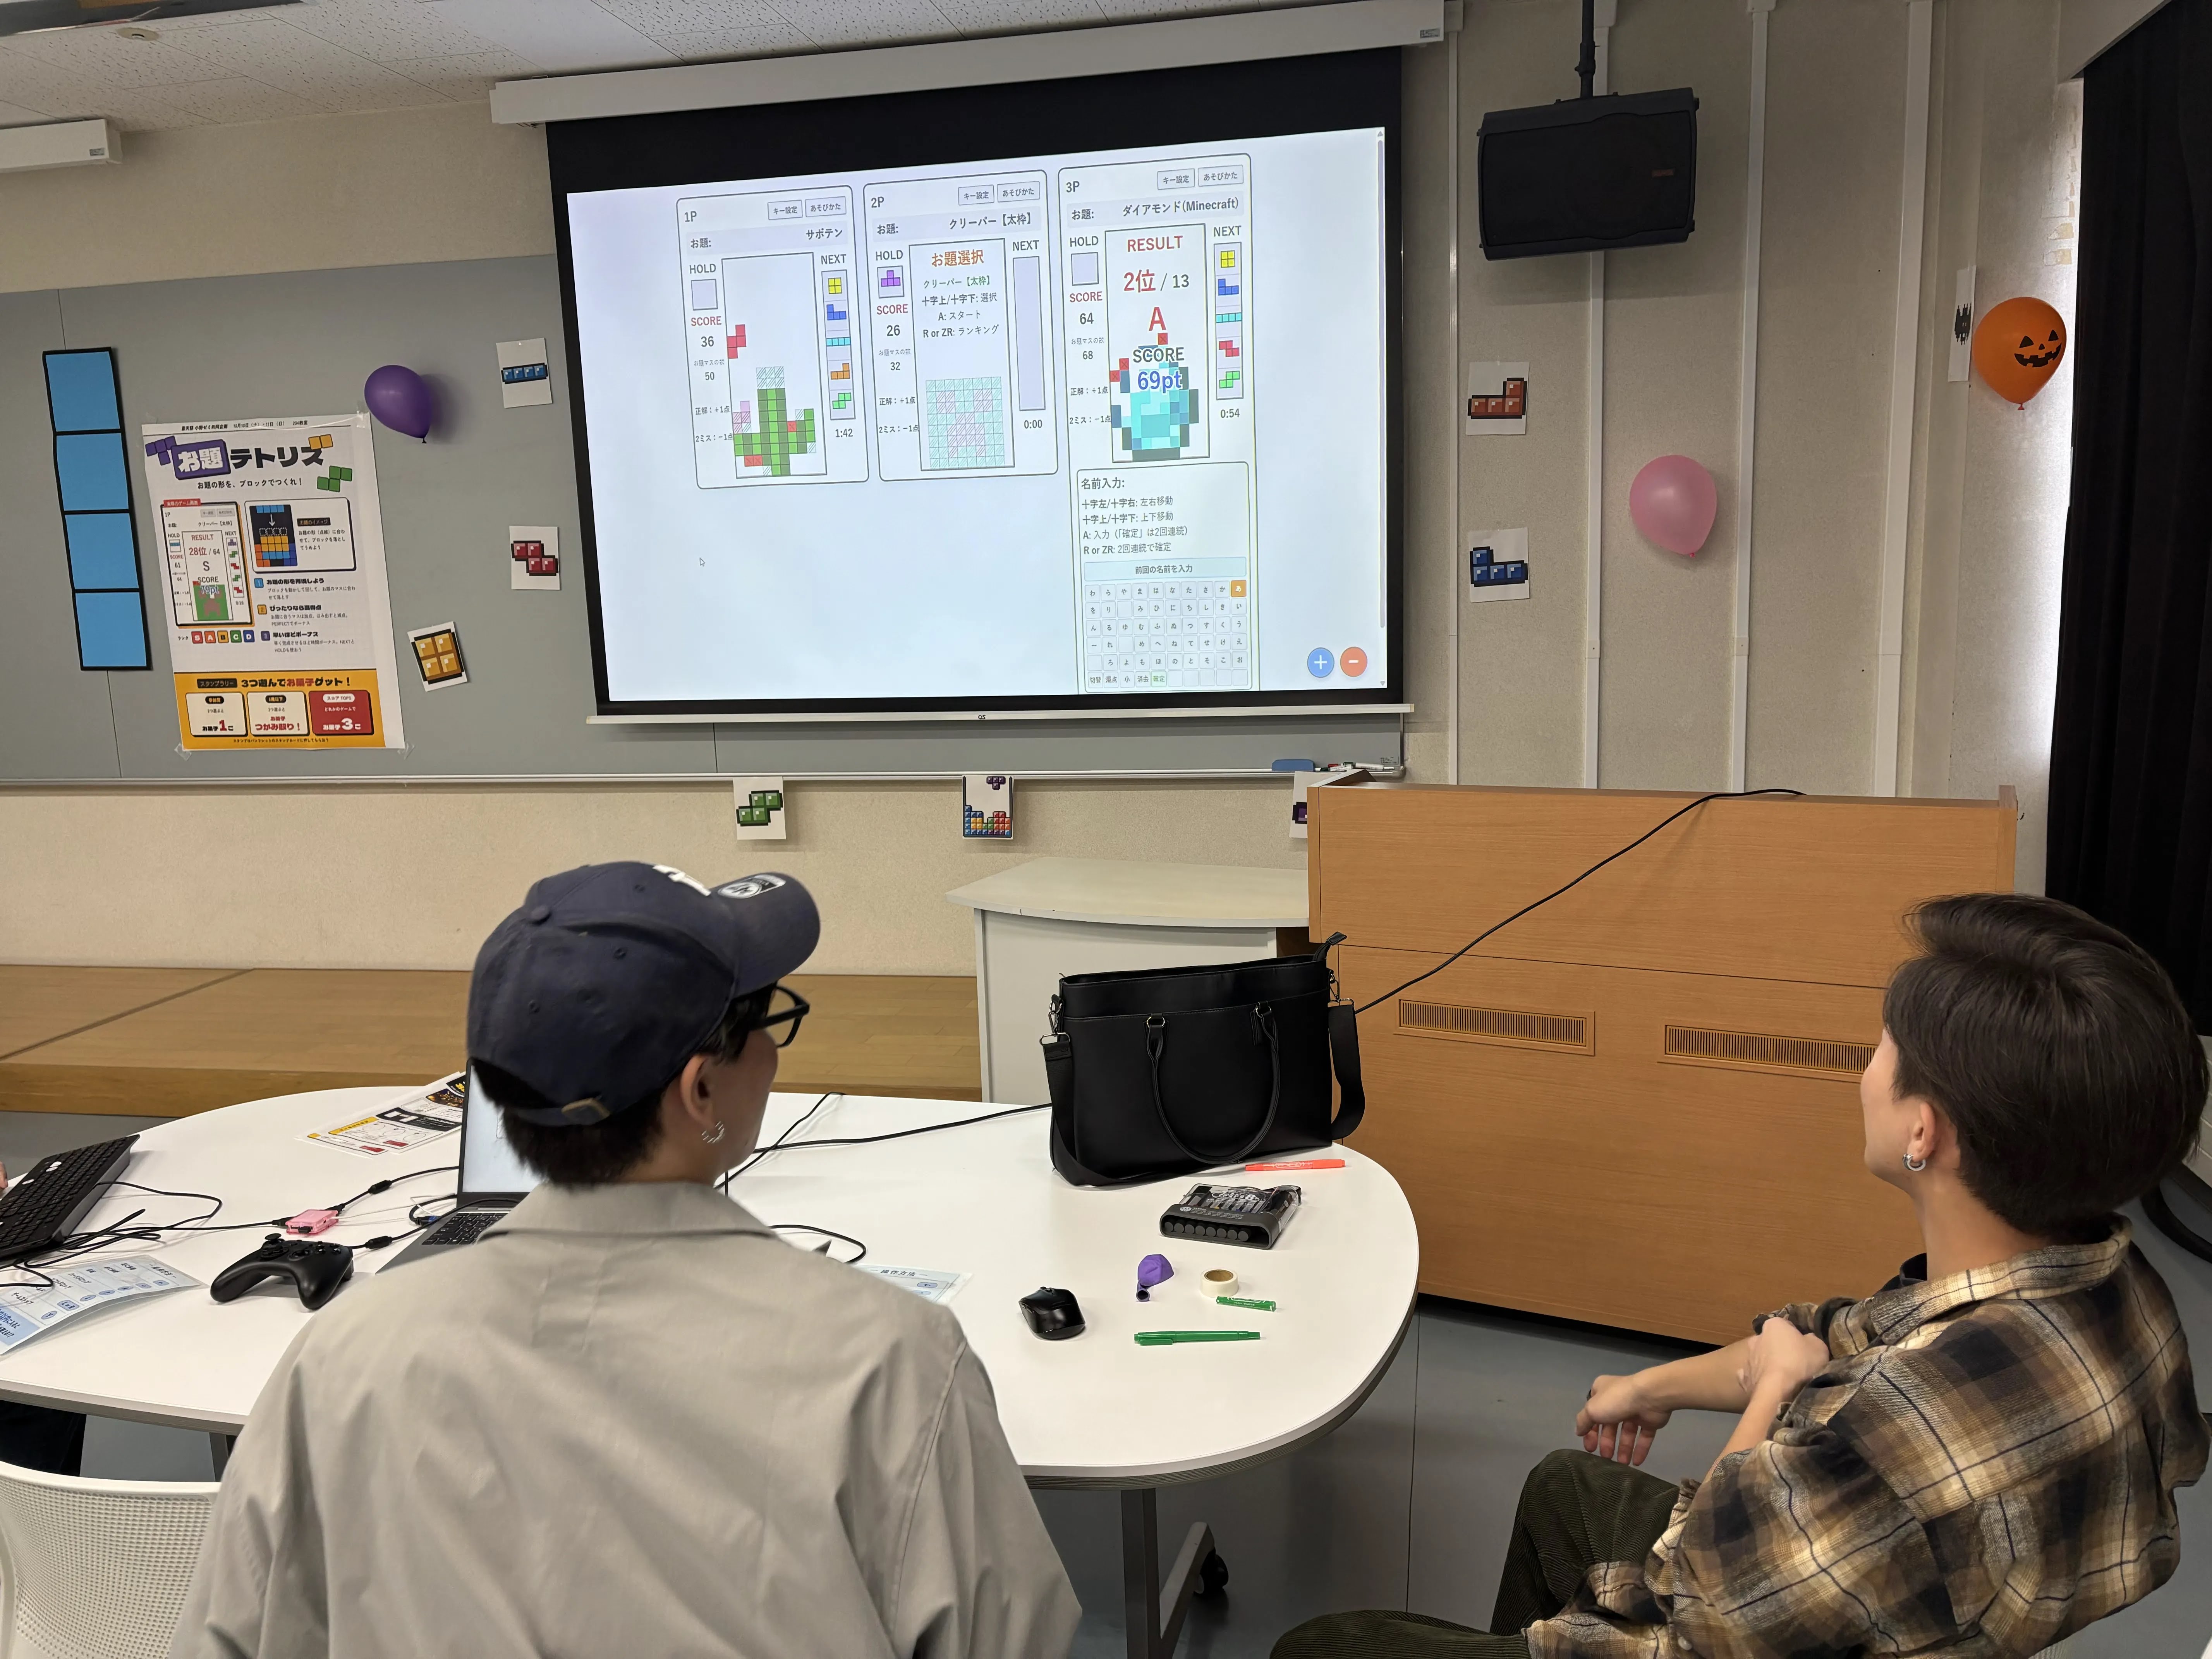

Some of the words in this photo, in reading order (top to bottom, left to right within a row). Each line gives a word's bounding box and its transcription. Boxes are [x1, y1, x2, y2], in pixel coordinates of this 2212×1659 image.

[1163, 175, 1189, 184] キー設定
[1204, 171, 1237, 180] あそびかた
[1066, 181, 1080, 192] 3P
[964, 191, 989, 199] キー設定
[1003, 187, 1034, 197] あそびかた
[811, 203, 841, 212] あそびかた
[871, 197, 884, 208] 2P
[773, 206, 798, 215] キー設定
[685, 211, 697, 222] 1P
[806, 228, 843, 240] サボテン
[1214, 225, 1242, 237] NEXT
[1013, 240, 1039, 251] NEXT
[1070, 236, 1098, 247] HOLD
[1128, 235, 1183, 252] RESULT
[821, 254, 846, 264] NEXT
[876, 250, 903, 260] HOLD
[931, 249, 984, 267] お題選択
[690, 264, 716, 274] HOLD
[1124, 269, 1156, 293] 2位
[1173, 274, 1189, 288] 13
[981, 292, 997, 302] 選択
[1070, 292, 1103, 302] SCORE
[877, 304, 908, 315] SCORE
[938, 312, 946, 321] A:
[950, 310, 981, 320] スタート
[1080, 313, 1094, 324] 64
[1149, 307, 1166, 331] A
[691, 316, 722, 326] SCORE
[887, 325, 900, 336] 26
[923, 330, 928, 338] R
[942, 328, 955, 337] ZR:
[958, 324, 999, 335] ランキング
[701, 337, 714, 347] 36
[1083, 351, 1093, 360] 68
[1133, 347, 1185, 362] SCORE
[890, 362, 900, 370] 32
[705, 372, 714, 380] 50
[1138, 371, 1182, 393] 69pt
[1221, 409, 1240, 418] 0:54
[1024, 420, 1042, 429] 0:00
[835, 429, 853, 438] 1:42
[178, 447, 223, 472] お題
[230, 446, 324, 469] テトリス
[1082, 477, 1125, 489] 名前入力:
[1140, 496, 1173, 507] 左右移動
[1141, 511, 1173, 522] 上下移動
[189, 547, 207, 555] 28位
[1118, 543, 1171, 553] 2回連続で確定
[203, 561, 210, 571] S
[1135, 564, 1192, 574] 前回の名前を入力
